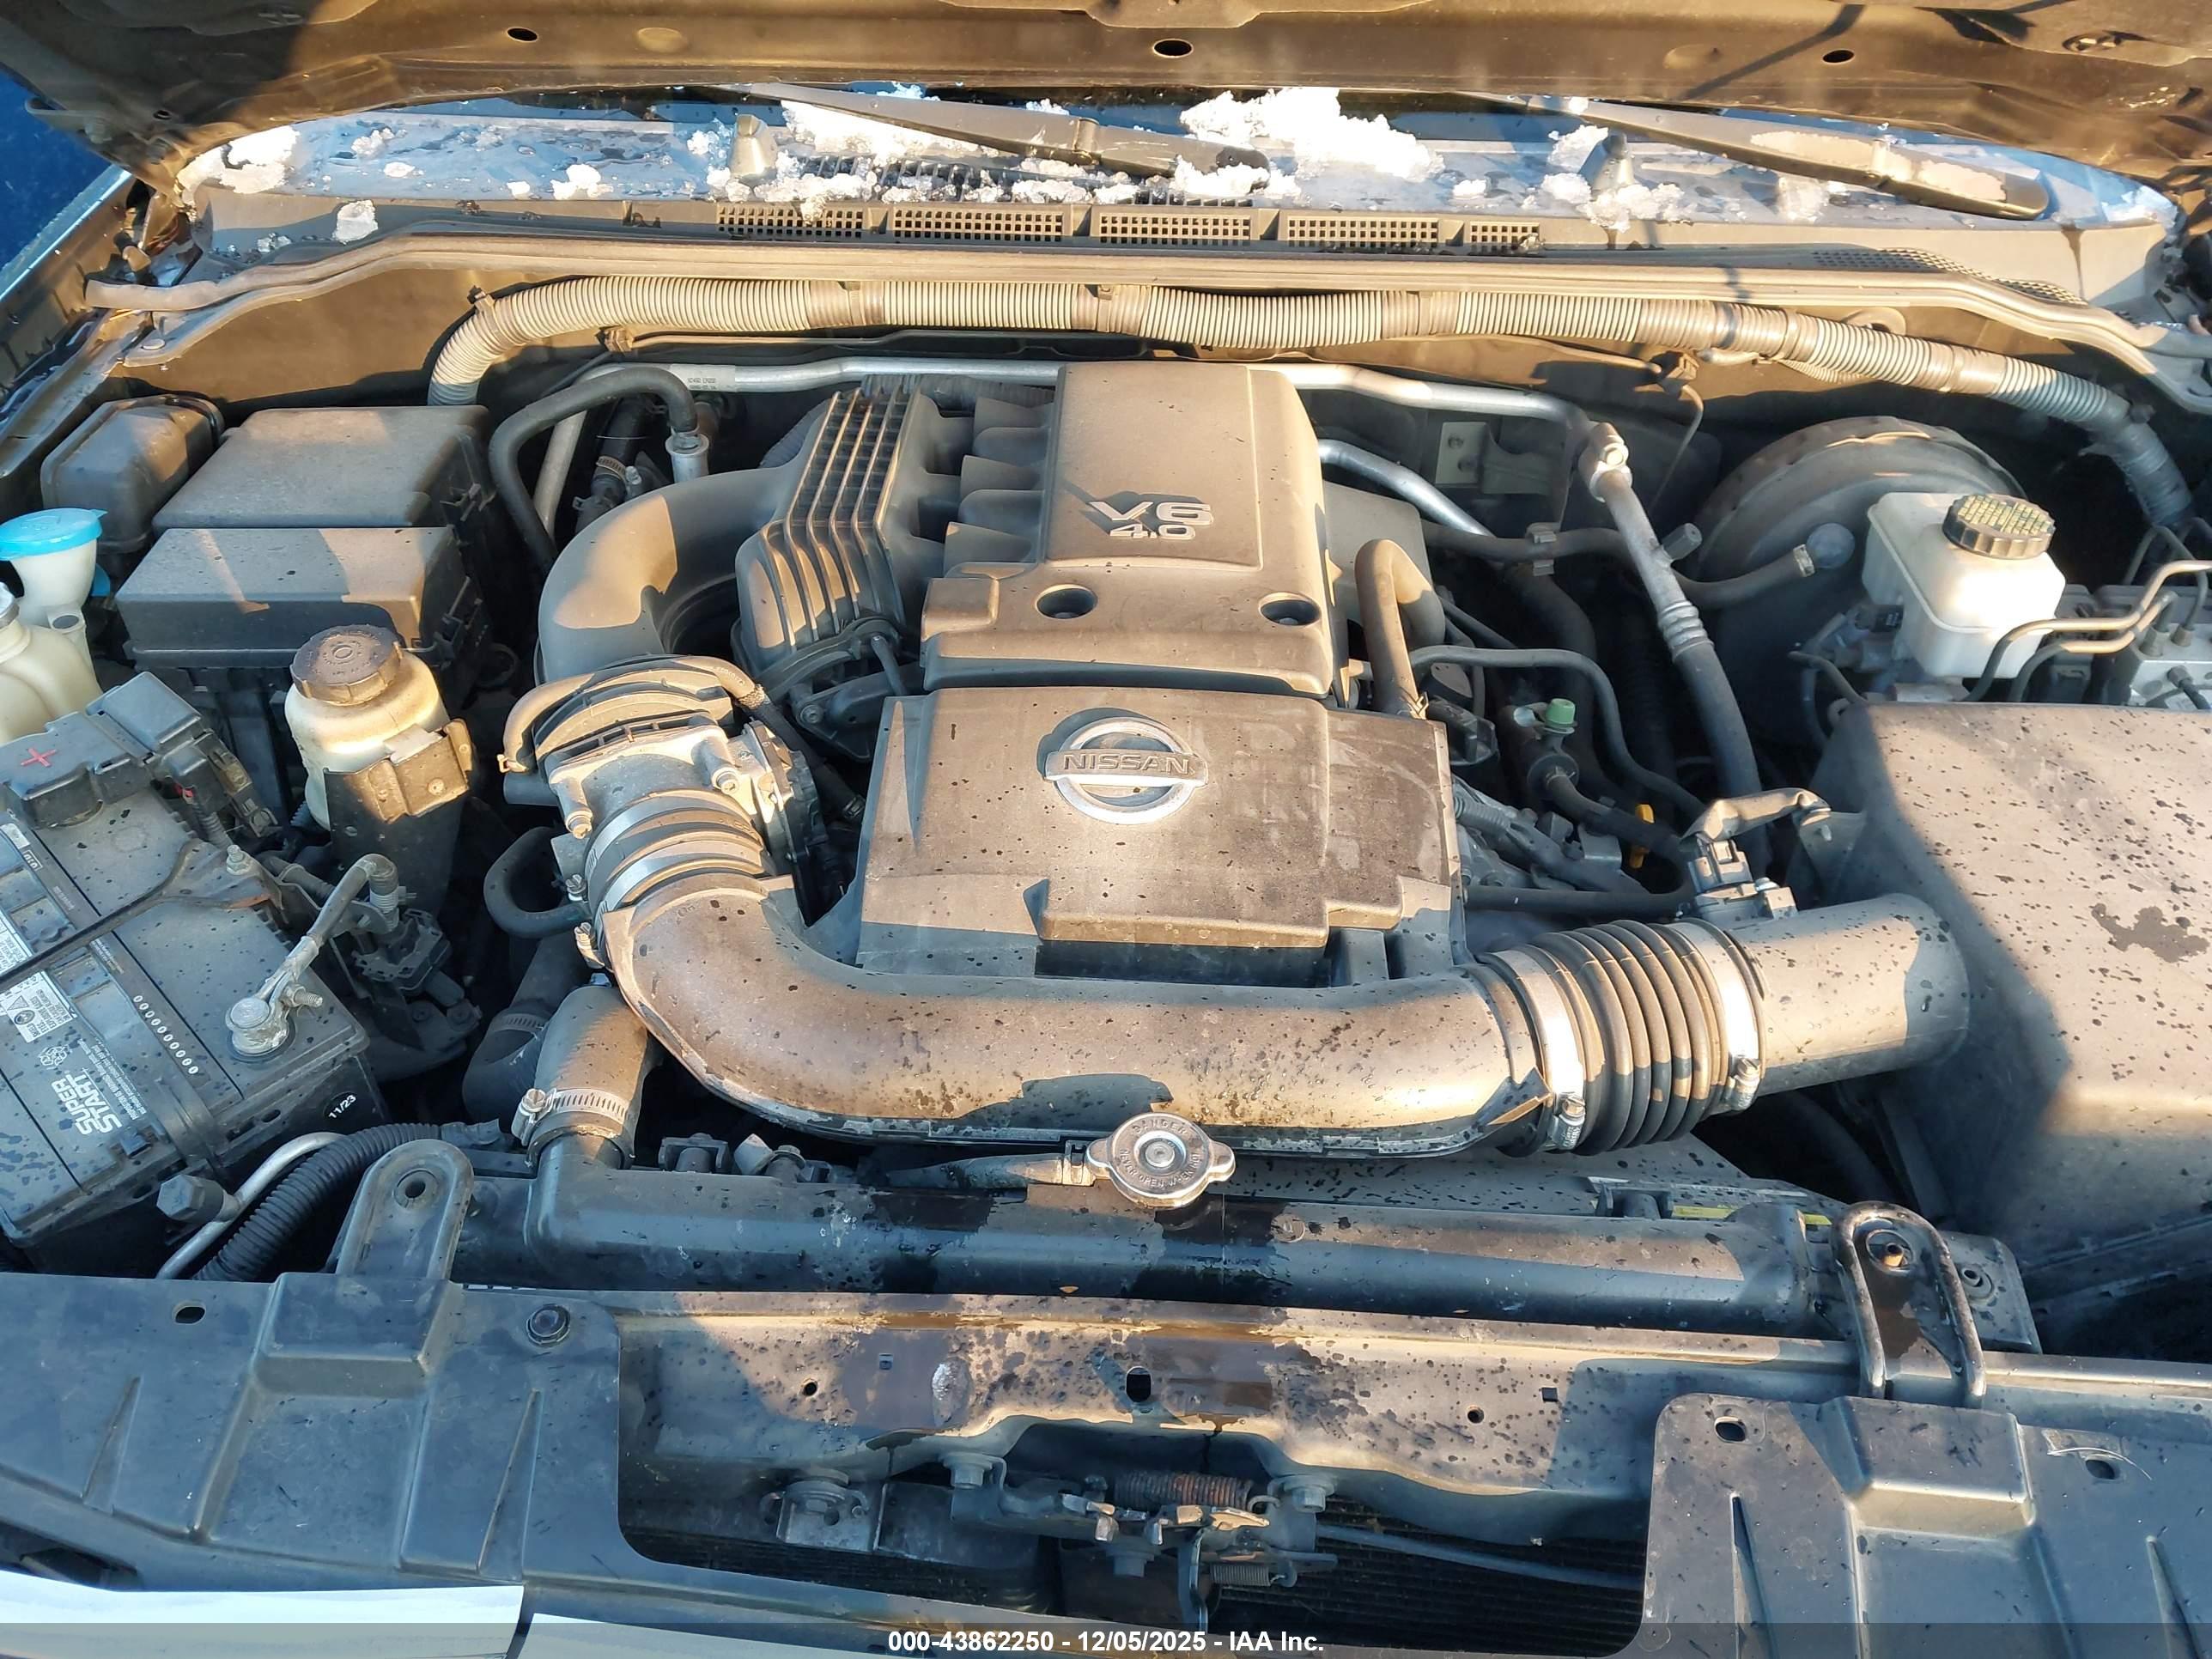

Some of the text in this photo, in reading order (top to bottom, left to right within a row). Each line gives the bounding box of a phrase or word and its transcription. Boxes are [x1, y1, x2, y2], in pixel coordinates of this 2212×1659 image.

[1089, 501, 1214, 526] V6
[1109, 522, 1196, 540] 4.0
[1063, 753, 1190, 775] NISSAN
[52, 1079, 100, 1134] SUPER
[66, 1074, 122, 1133] START
[328, 1094, 356, 1119] 11/23
[1132, 1119, 1188, 1134] DANGER
[1119, 1149, 1138, 1176] NEVER
[1139, 1175, 1164, 1188] OPEN
